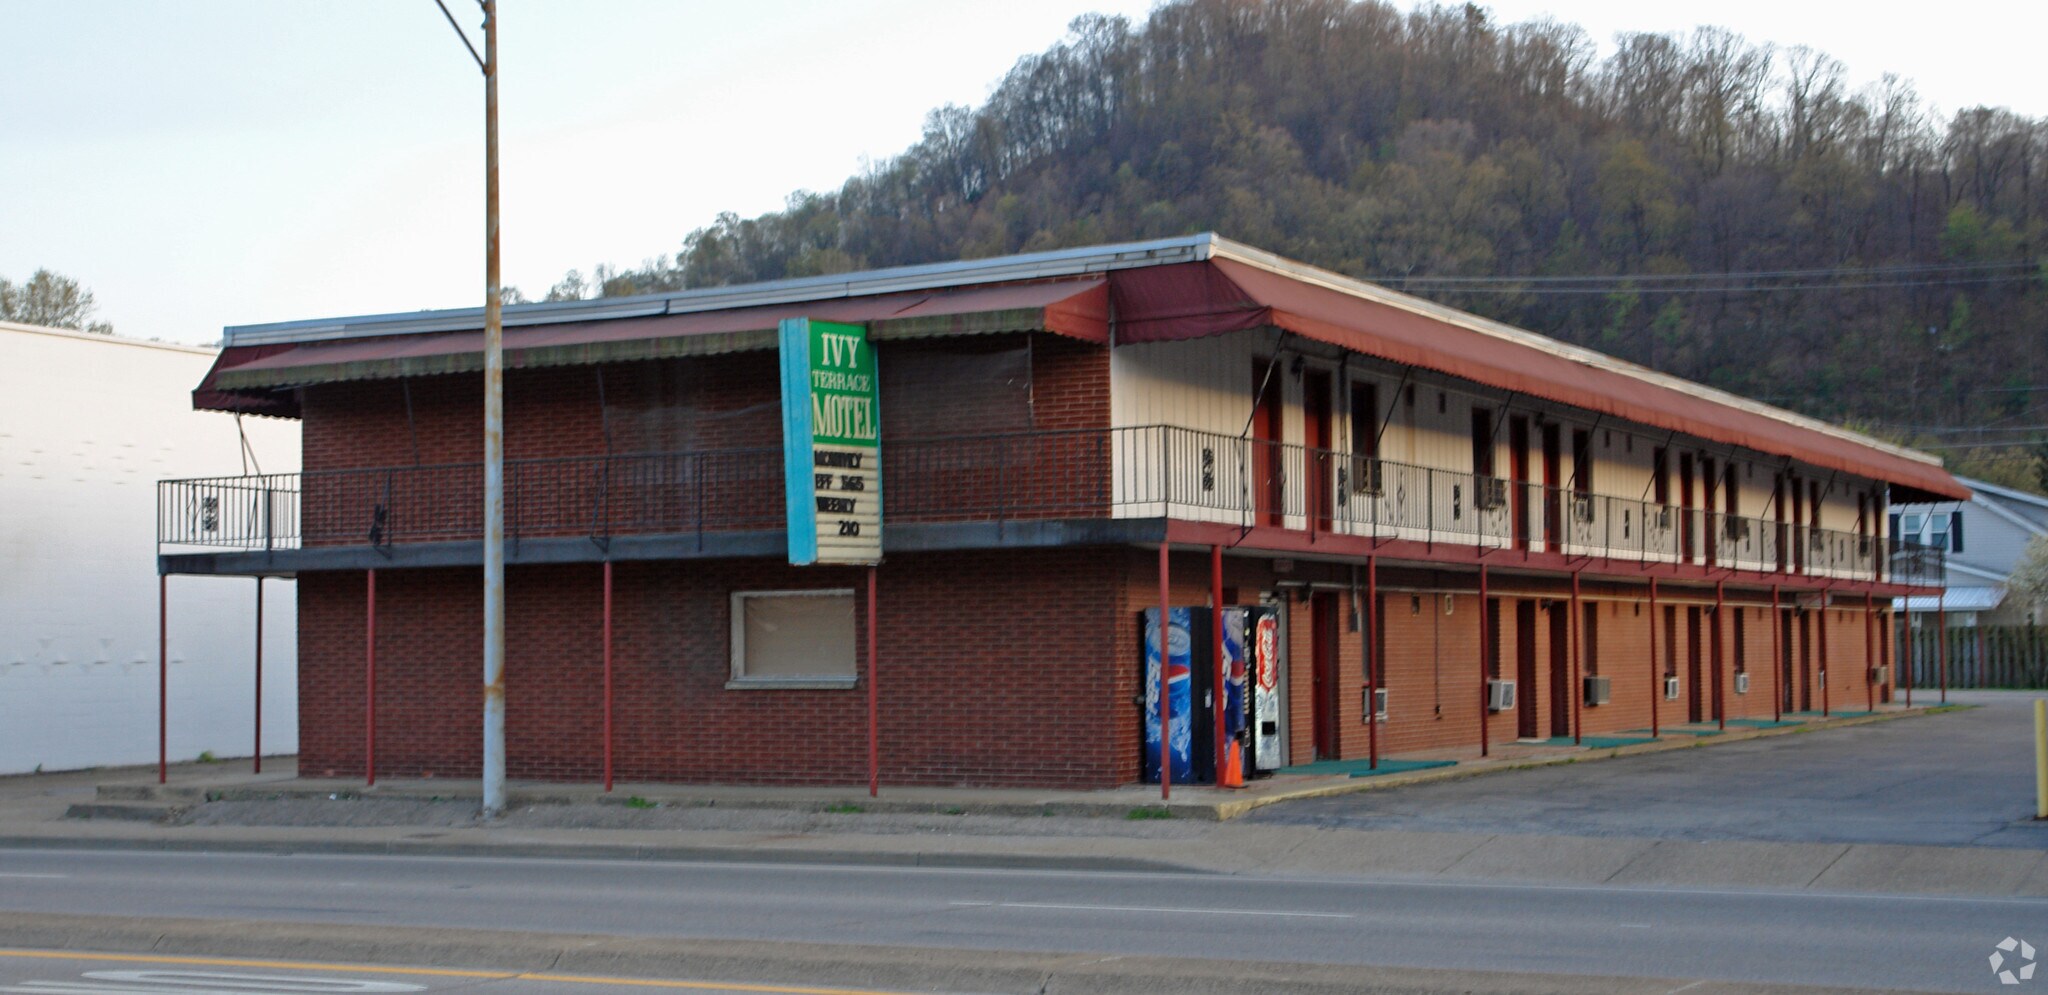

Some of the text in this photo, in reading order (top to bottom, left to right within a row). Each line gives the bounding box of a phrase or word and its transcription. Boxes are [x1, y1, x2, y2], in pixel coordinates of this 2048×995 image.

[821, 332, 860, 368] IVY
[811, 369, 871, 393] TERRACE
[811, 392, 877, 440] MOTEL
[838, 520, 861, 537] 210
